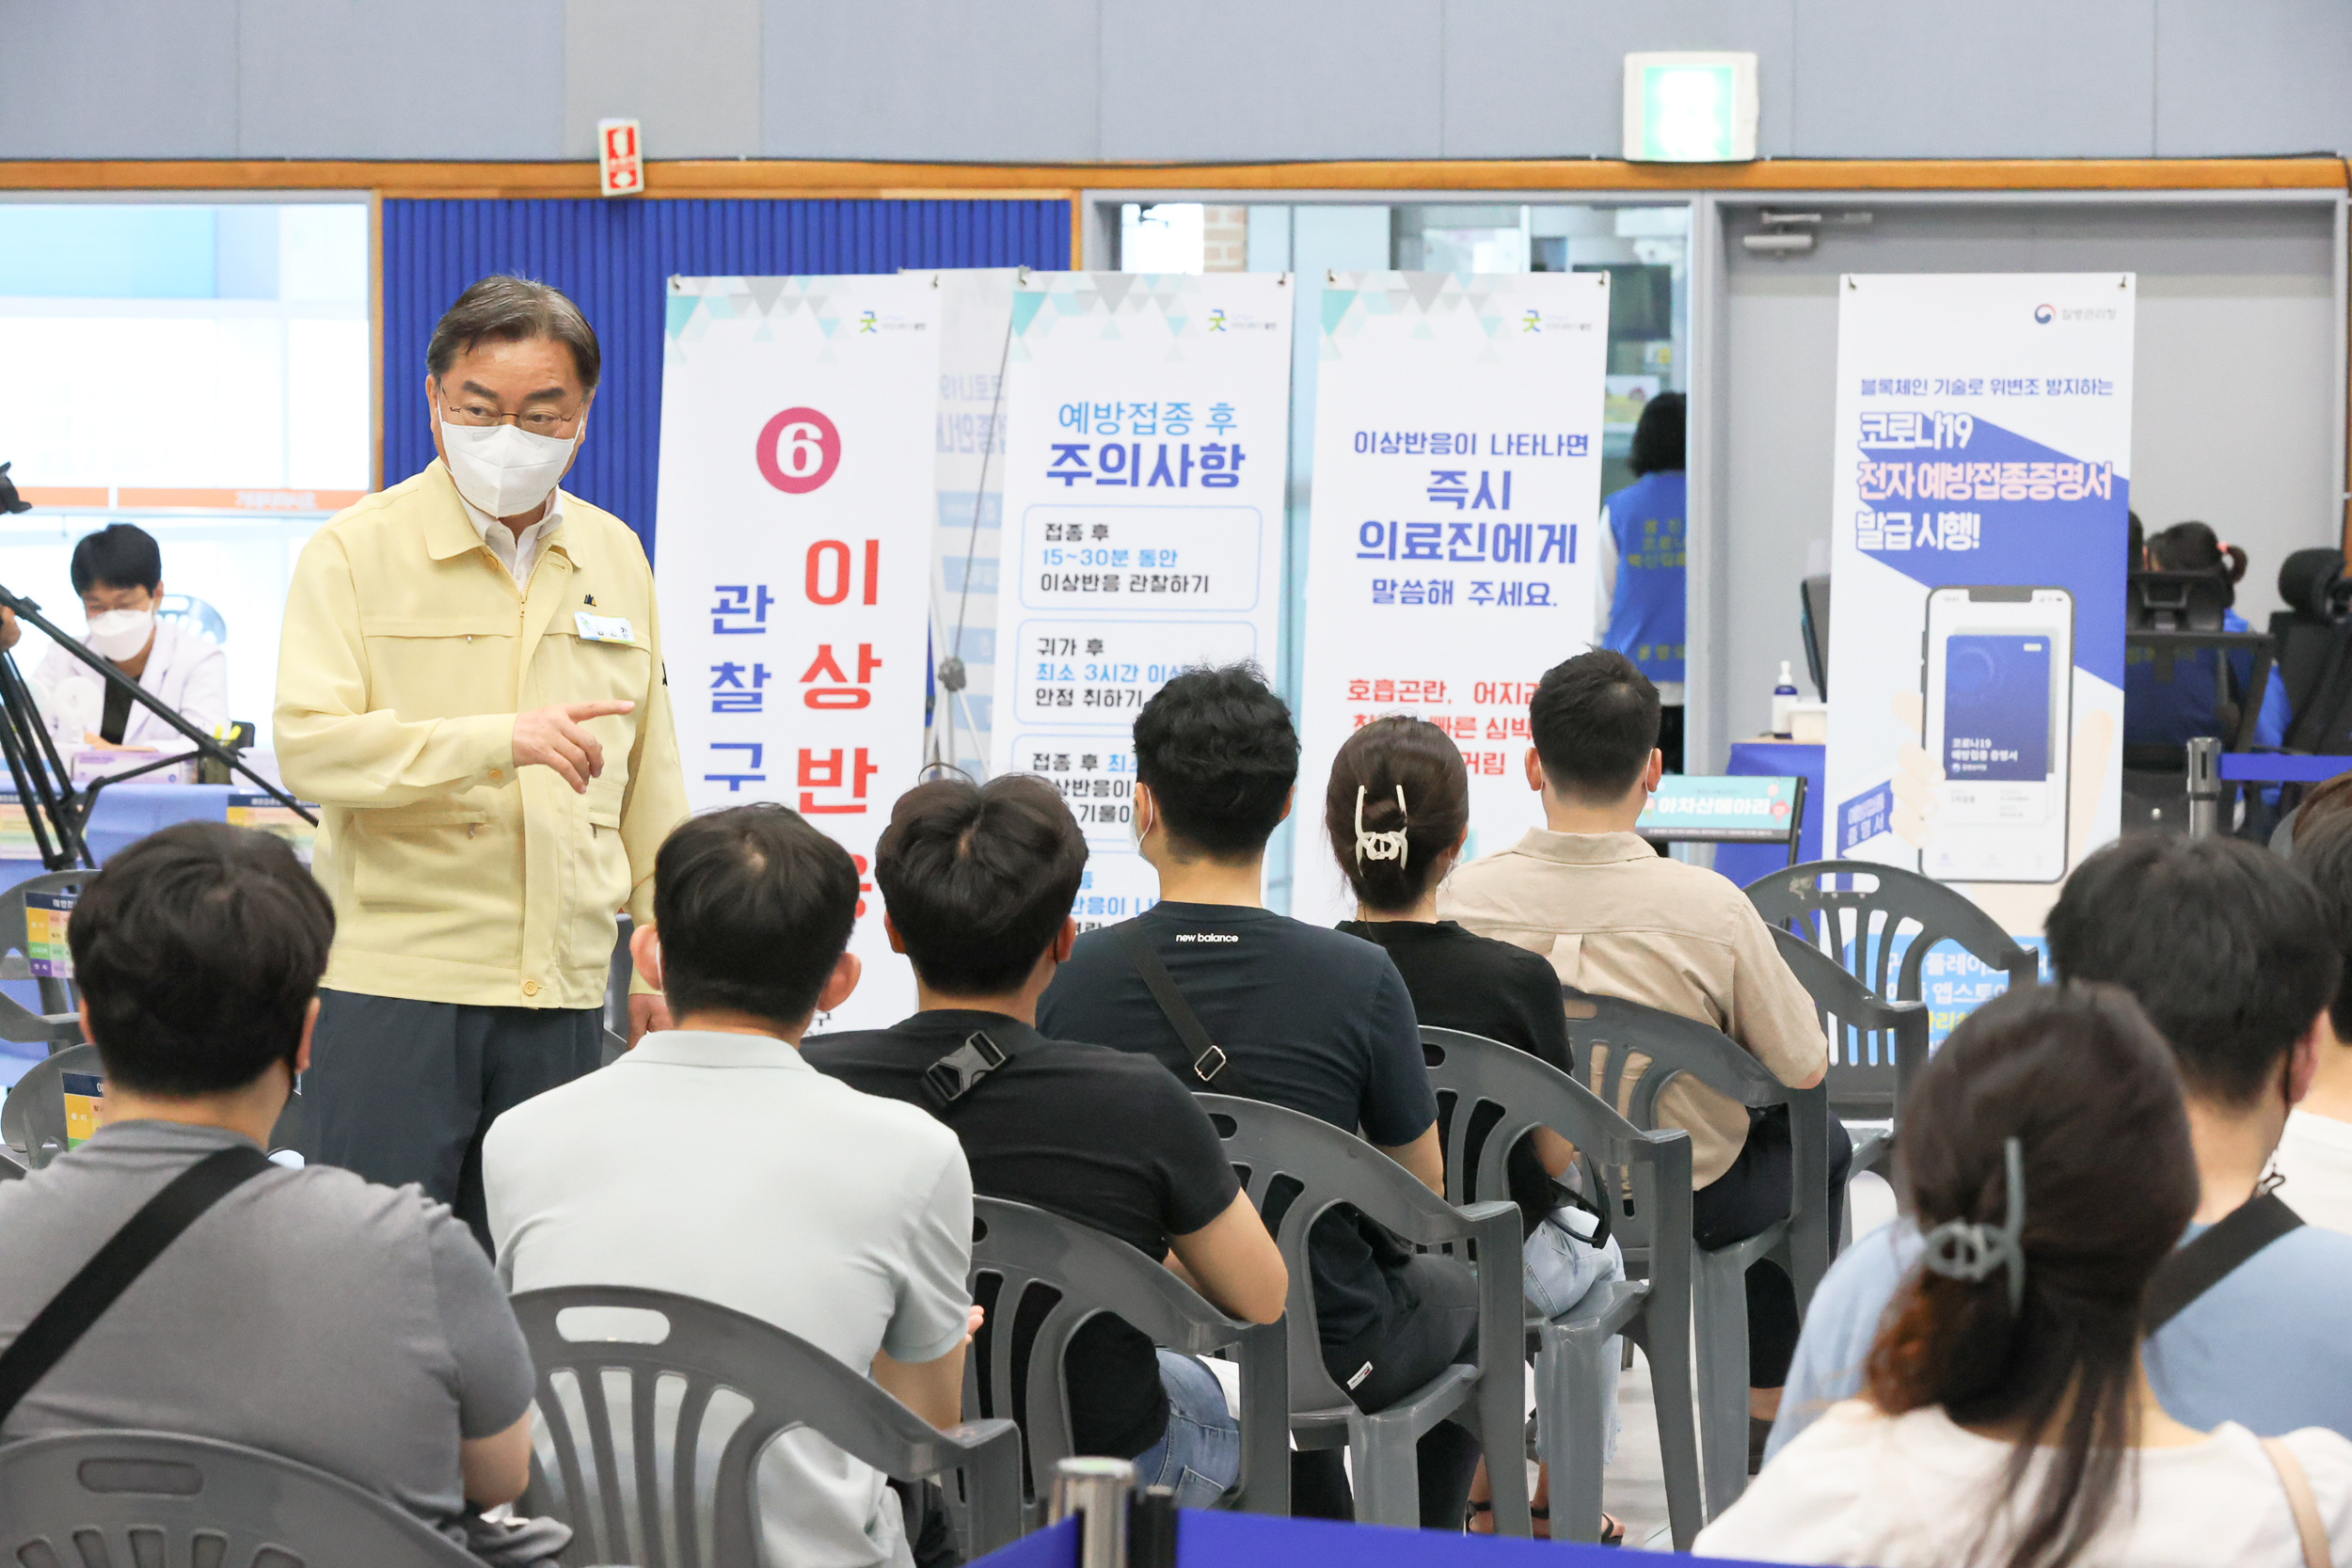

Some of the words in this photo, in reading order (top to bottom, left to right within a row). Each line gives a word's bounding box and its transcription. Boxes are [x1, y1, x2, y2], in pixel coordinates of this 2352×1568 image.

[1861, 378, 1929, 397] 블록체인
[1933, 378, 1984, 396] 기술로
[1990, 378, 2040, 396] 위변조
[2046, 378, 2112, 396] 방지하는
[1058, 401, 1194, 436] 예방접종
[1205, 403, 1238, 436] 후
[1858, 412, 1975, 451] 코로나19
[776, 421, 823, 478] 6
[1354, 431, 1477, 455] 이상반응이
[1490, 433, 1589, 457] 나타나면
[1046, 442, 1247, 488] 주의사항
[1426, 469, 1512, 511] 즉시
[1856, 461, 1915, 500] 전자
[1917, 462, 2112, 500] 예방접종증명서
[1045, 523, 1084, 542] 접종
[1090, 523, 1109, 542] 후
[1356, 520, 1578, 564] 의료진에게
[1856, 511, 1914, 550] 발급
[1915, 511, 1981, 550] 시행!
[1043, 548, 1129, 568] 15~30분
[1138, 548, 1179, 568] 동안
[1041, 573, 1120, 593] 이상반응
[1129, 574, 1209, 594] 관찰하기
[1372, 578, 1454, 606] 말씀해
[1468, 580, 1558, 607] 주세요.
[1038, 638, 1077, 657] 귀가
[1085, 638, 1104, 657] 후
[1036, 662, 1075, 681] 최소
[1084, 663, 1139, 683] 3시간
[1036, 688, 1073, 707] 안정
[1082, 689, 1143, 707] 취하기
[1033, 752, 1071, 772] 접종
[1080, 753, 1099, 772] 후
[1175, 934, 1197, 942] new
[1197, 932, 1239, 942] balance
